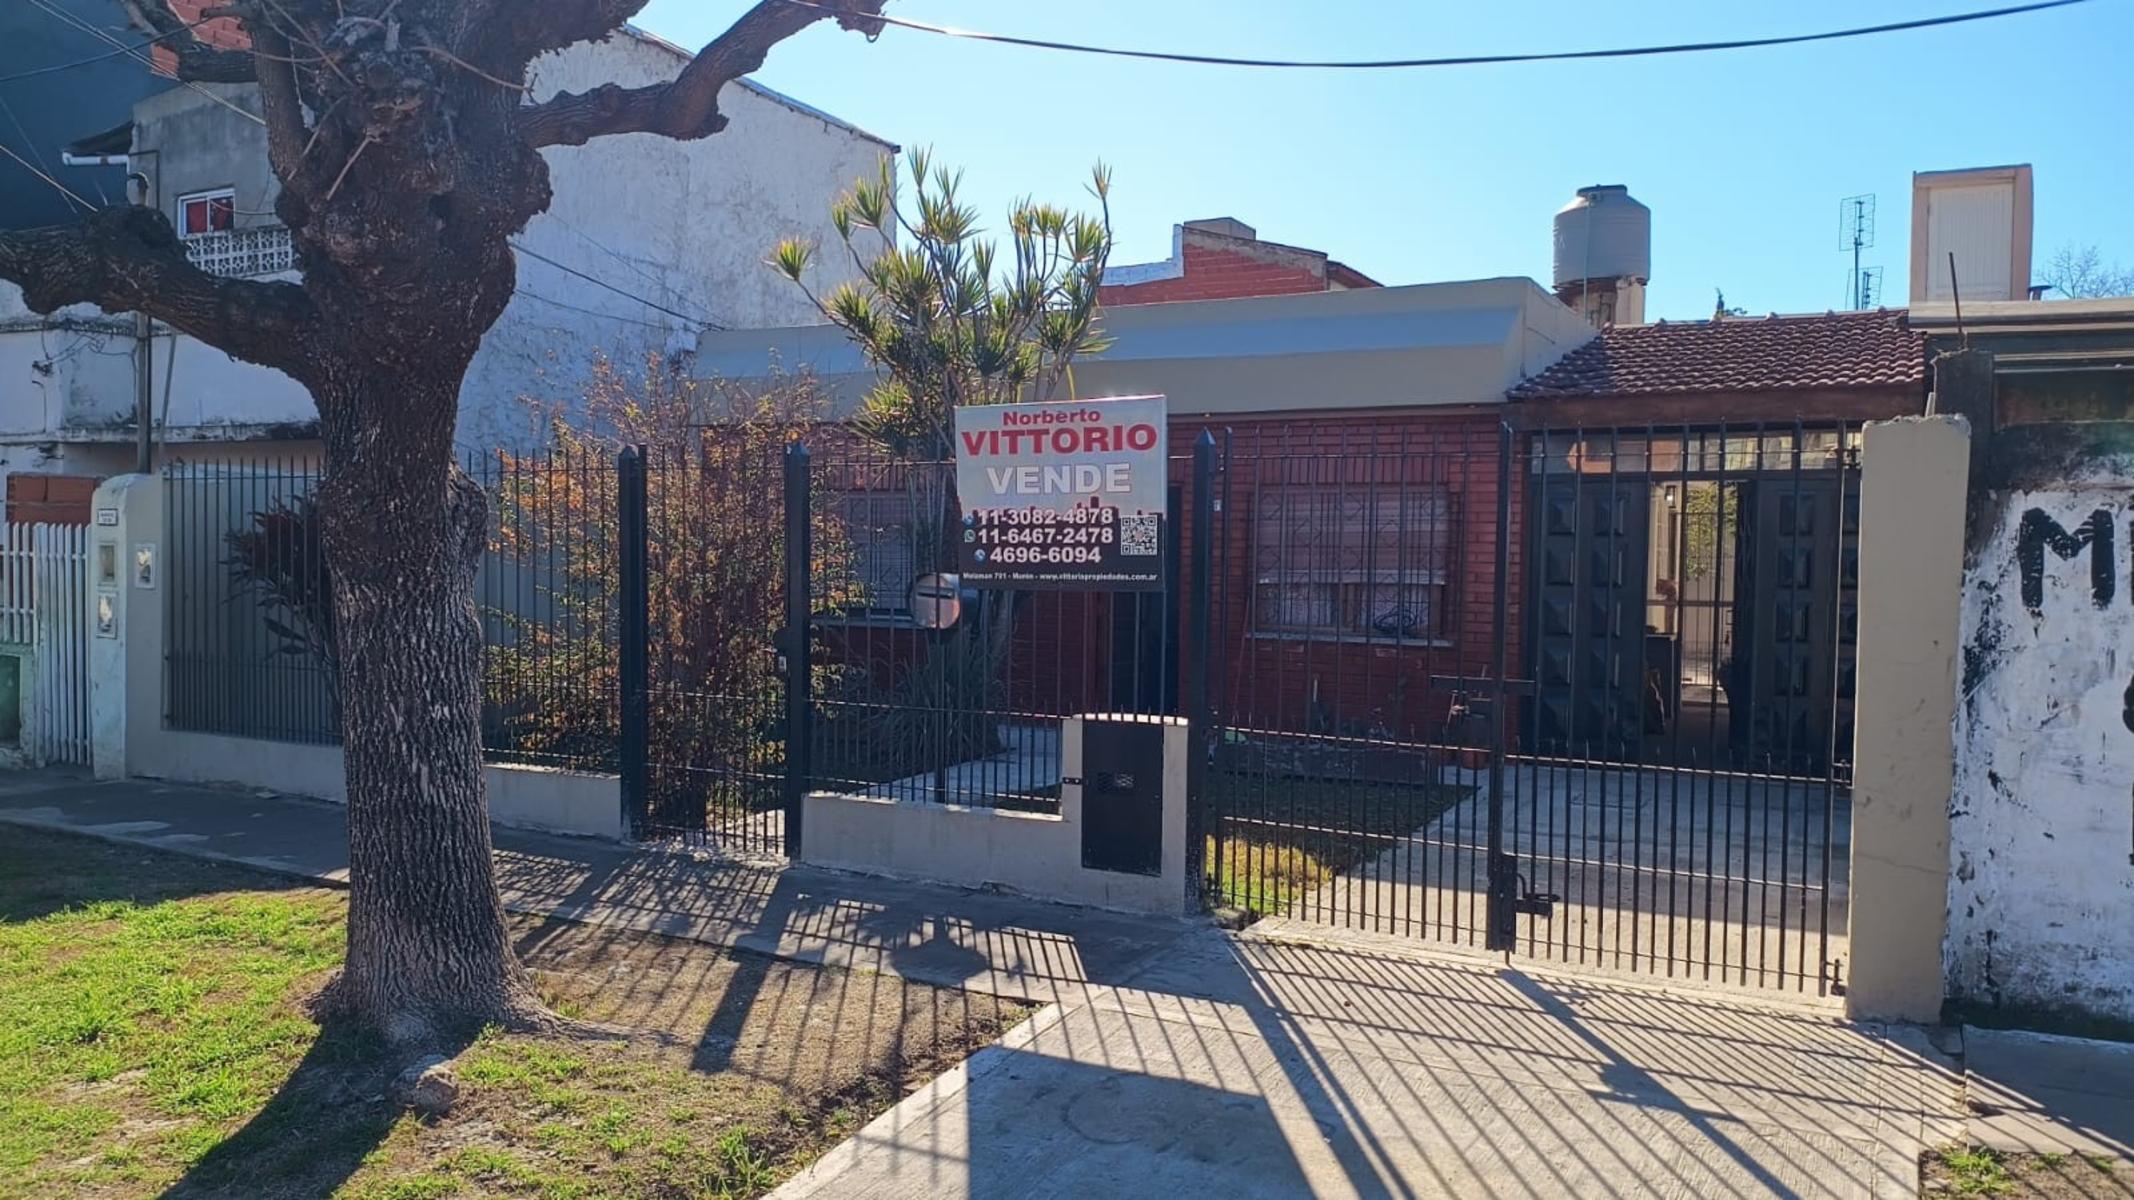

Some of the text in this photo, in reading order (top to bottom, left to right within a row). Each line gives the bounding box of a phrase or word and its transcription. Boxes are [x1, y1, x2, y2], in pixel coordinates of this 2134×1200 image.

[1002, 409, 1101, 426] Norberto
[961, 424, 1158, 456] VITTORIO
[986, 463, 1131, 495] VENDE
[978, 508, 1114, 525] 11-3082-4878
[978, 527, 1114, 544] 11-6467-2478
[989, 547, 1102, 563] 4696-6094
